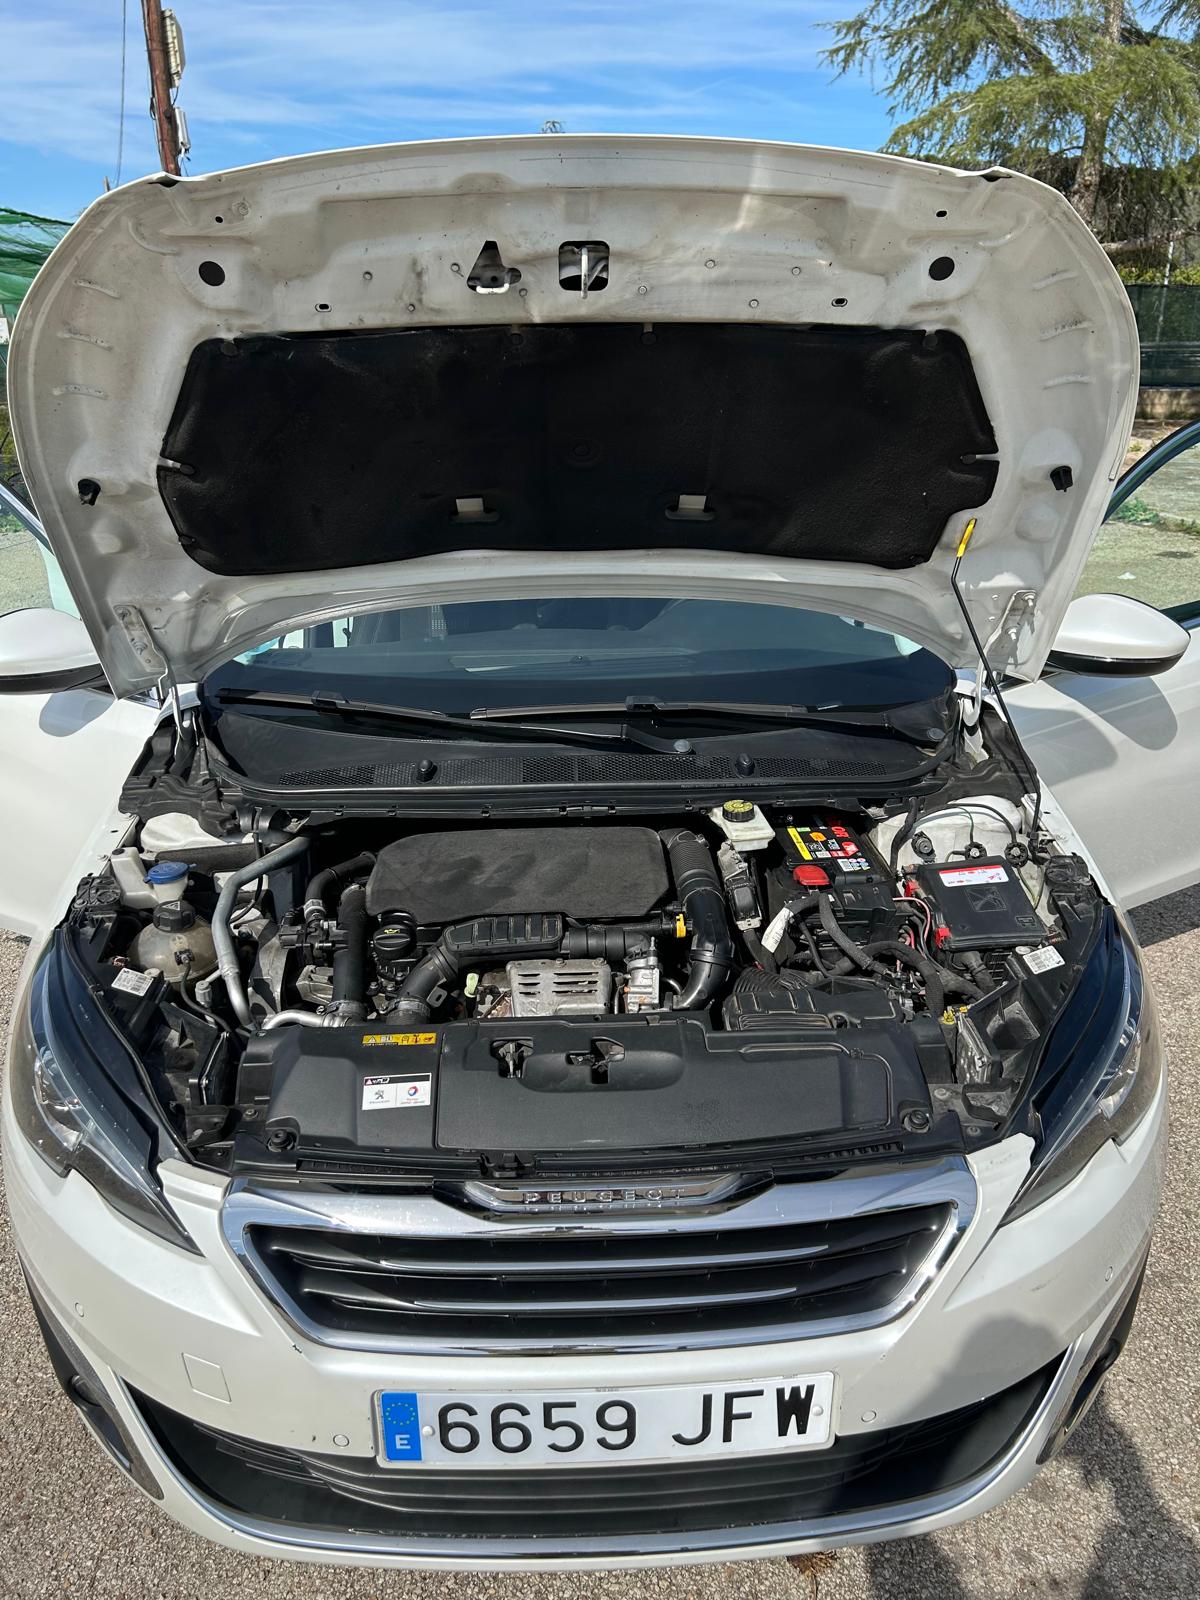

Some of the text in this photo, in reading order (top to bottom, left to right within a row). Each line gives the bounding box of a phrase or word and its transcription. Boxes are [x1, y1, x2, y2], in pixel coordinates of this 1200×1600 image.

[523, 1188, 685, 1204] PEUGEOT
[437, 1383, 816, 1454] 6659 JFW
[395, 1434, 411, 1450] E
